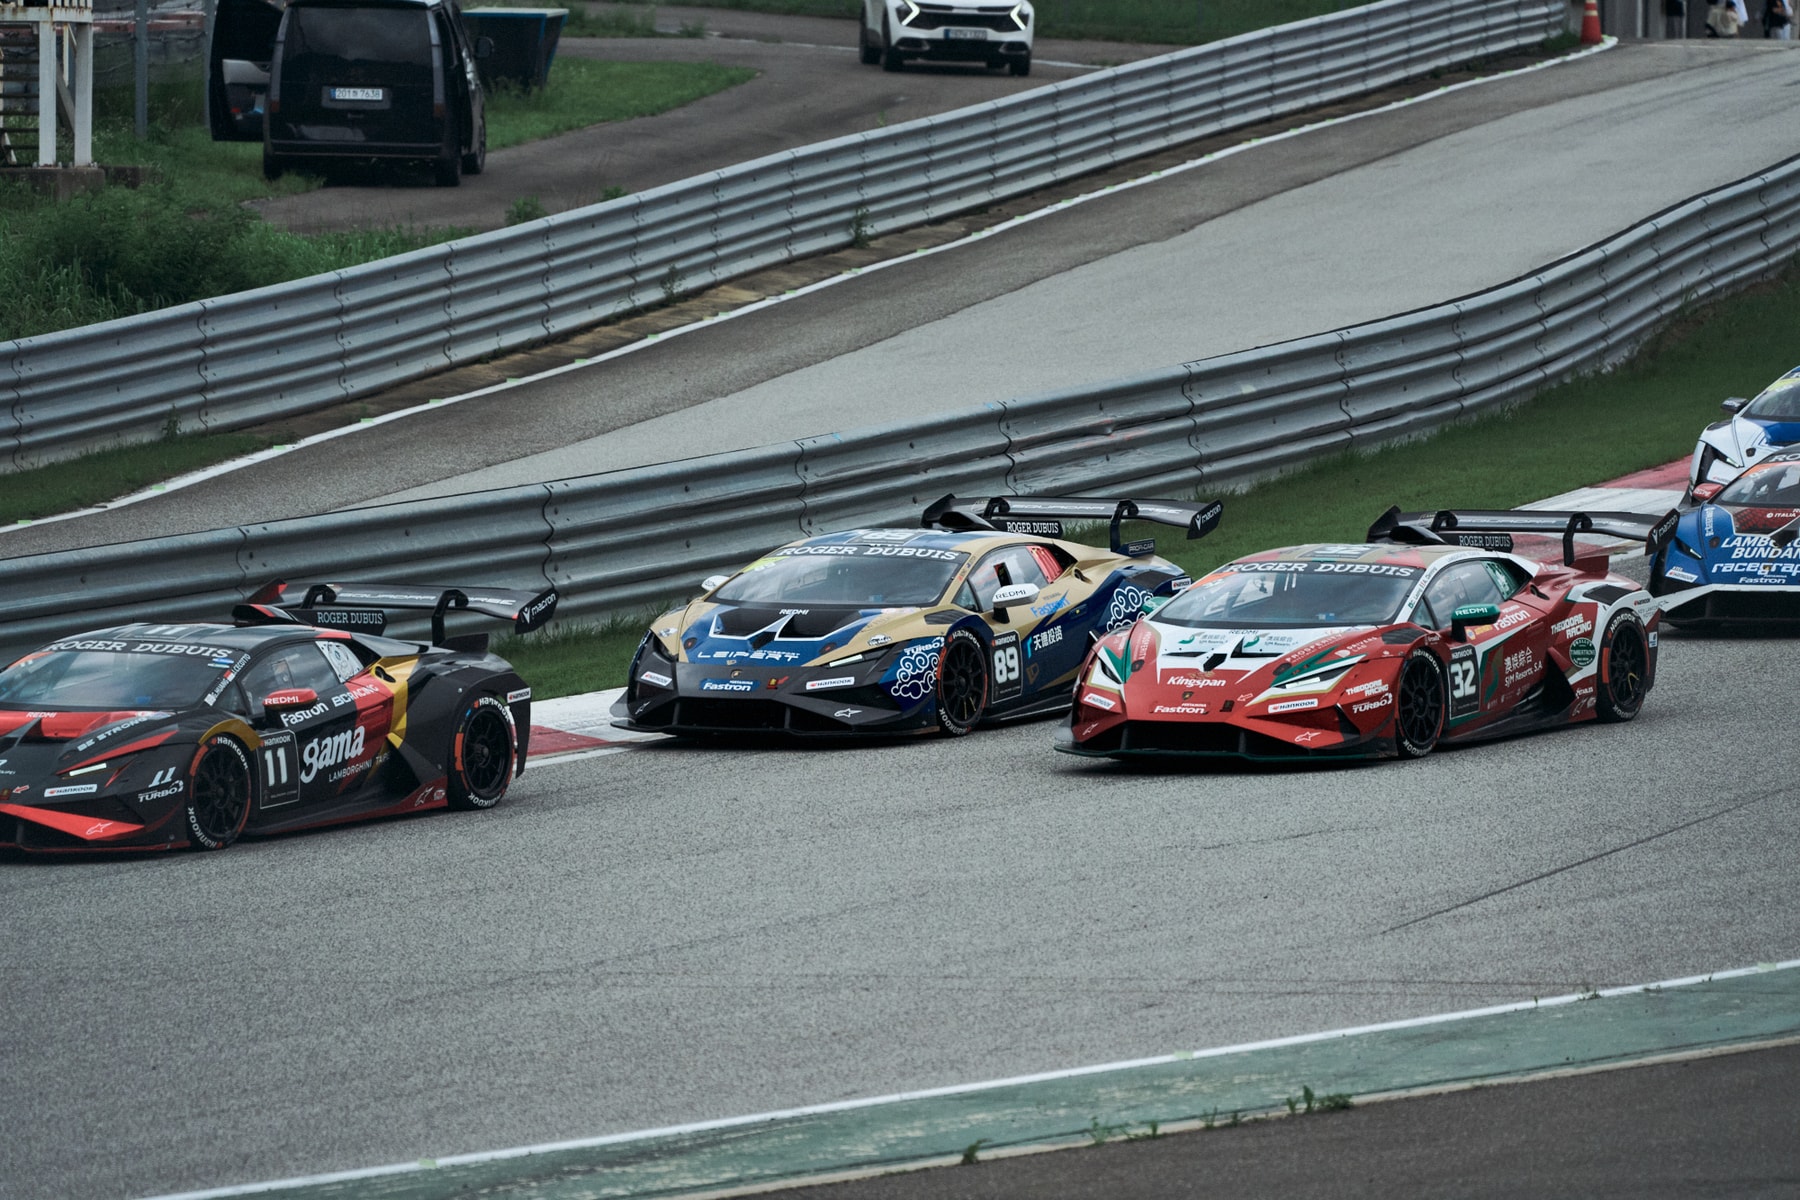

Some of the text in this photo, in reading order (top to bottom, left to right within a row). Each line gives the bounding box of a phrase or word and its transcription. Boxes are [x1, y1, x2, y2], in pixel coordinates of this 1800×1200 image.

[1202, 504, 1221, 524] macron
[1007, 521, 1059, 534] ROGER DUBUIS
[1459, 535, 1511, 548] ROGER DUBUIS
[778, 546, 960, 560] ROGER DUBUIS
[1227, 562, 1415, 578] ROGER DUBUIS
[995, 589, 1028, 601] REDMI
[531, 592, 556, 617] macron
[1455, 606, 1489, 617] REDMI
[317, 611, 383, 625] ROGER DUBUIS
[779, 609, 810, 617] REDMI
[1551, 613, 1585, 636] THEODORE
[1565, 620, 1593, 640] RACING
[43, 640, 233, 658] ROGER DUBUIS
[994, 646, 1020, 685] 89
[703, 682, 753, 692] Fastron
[1167, 676, 1227, 688] Kingspan
[1346, 679, 1383, 696] THEODORE
[1450, 660, 1477, 699] 32
[1364, 683, 1389, 698] RACING
[264, 695, 299, 705] REDMI
[280, 701, 329, 727] Fastron
[1155, 705, 1206, 715] Fastron
[77, 739, 96, 752] BE
[300, 725, 365, 783] gama
[264, 747, 288, 787] 11
[329, 759, 373, 783] LAMBORGHINI
[148, 766, 176, 788] 11
